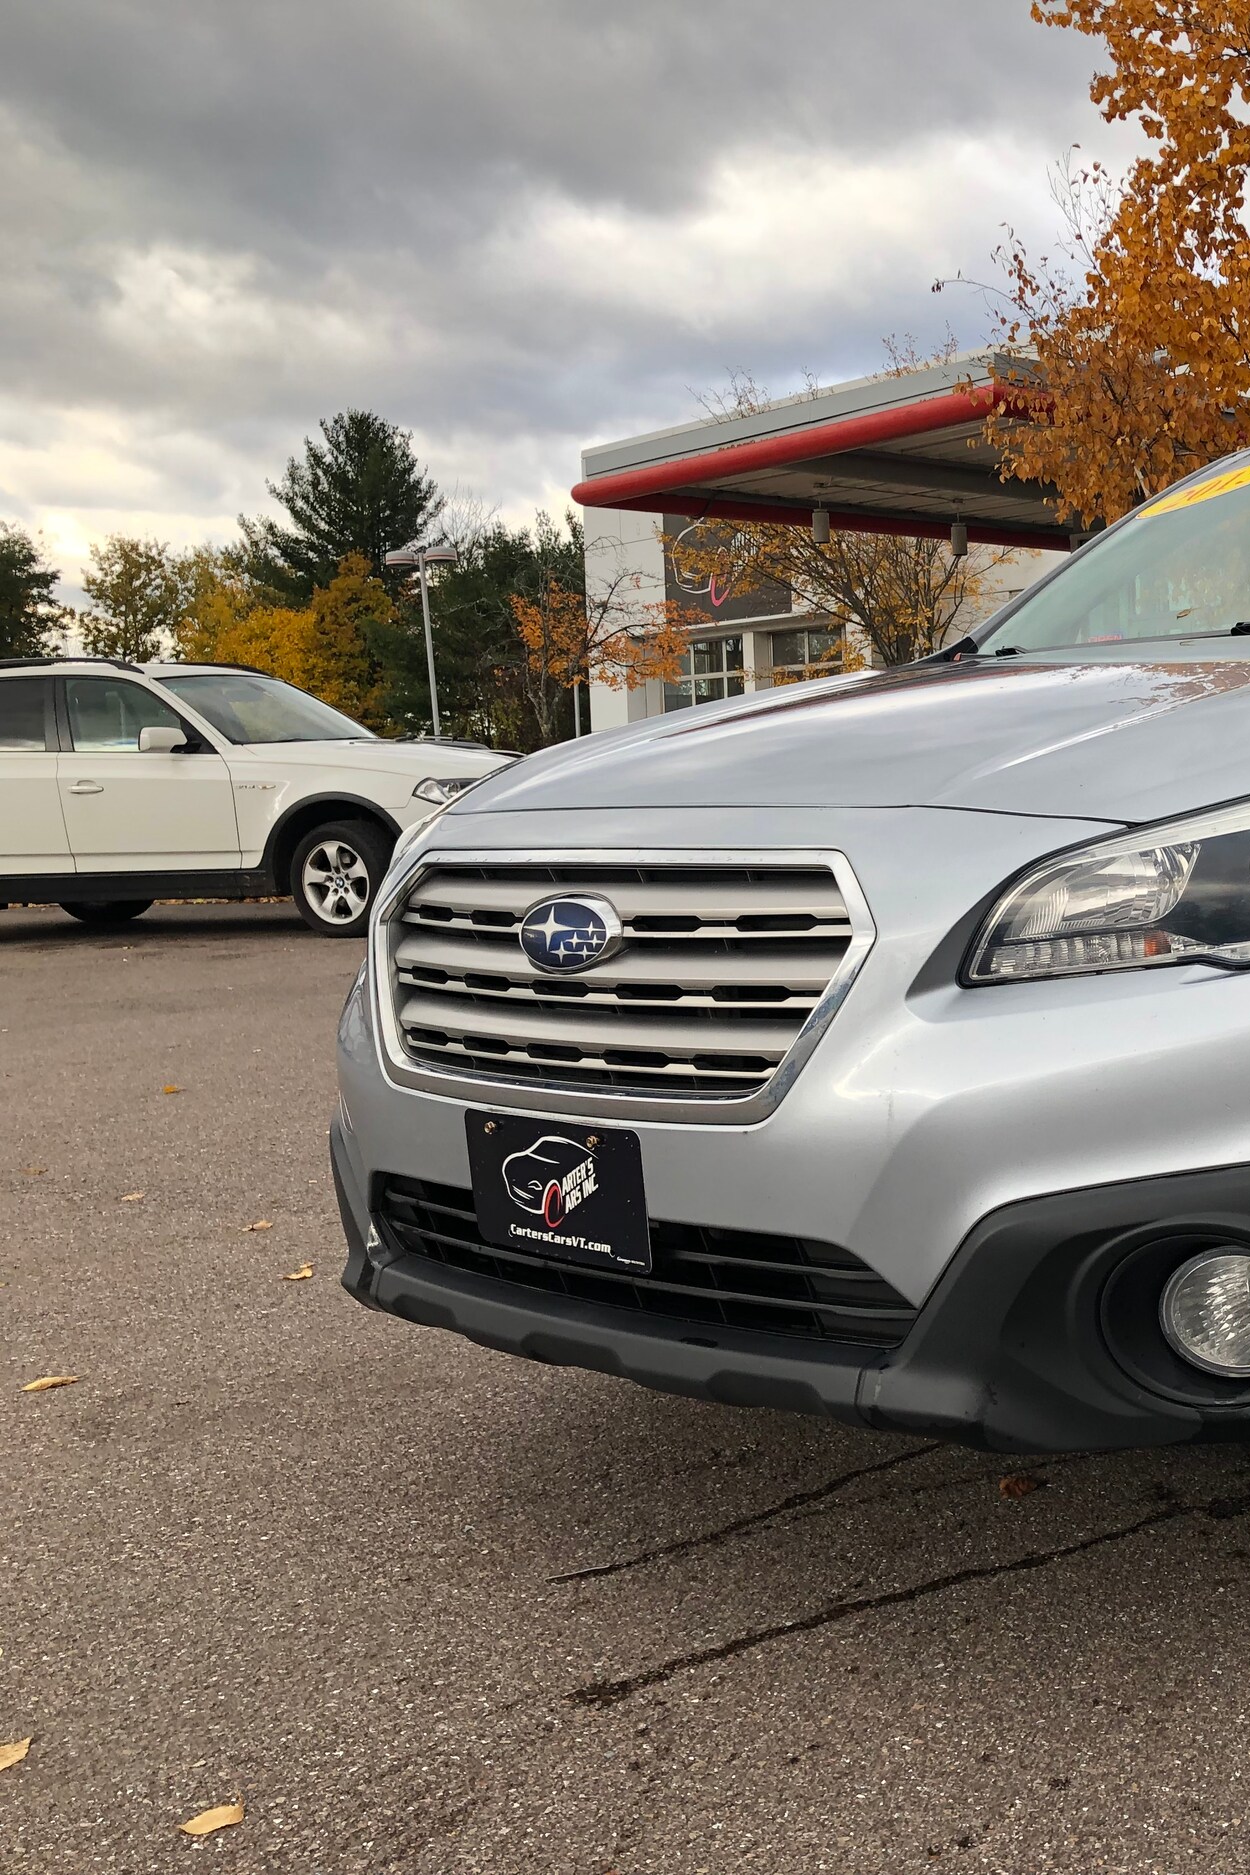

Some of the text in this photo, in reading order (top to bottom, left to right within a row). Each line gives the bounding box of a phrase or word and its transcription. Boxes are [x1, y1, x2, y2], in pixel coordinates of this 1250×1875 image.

[562, 1157, 593, 1196] ARTER'S
[565, 1185, 583, 1214] ARS
[510, 1224, 611, 1253] CartersCarsVT.com
